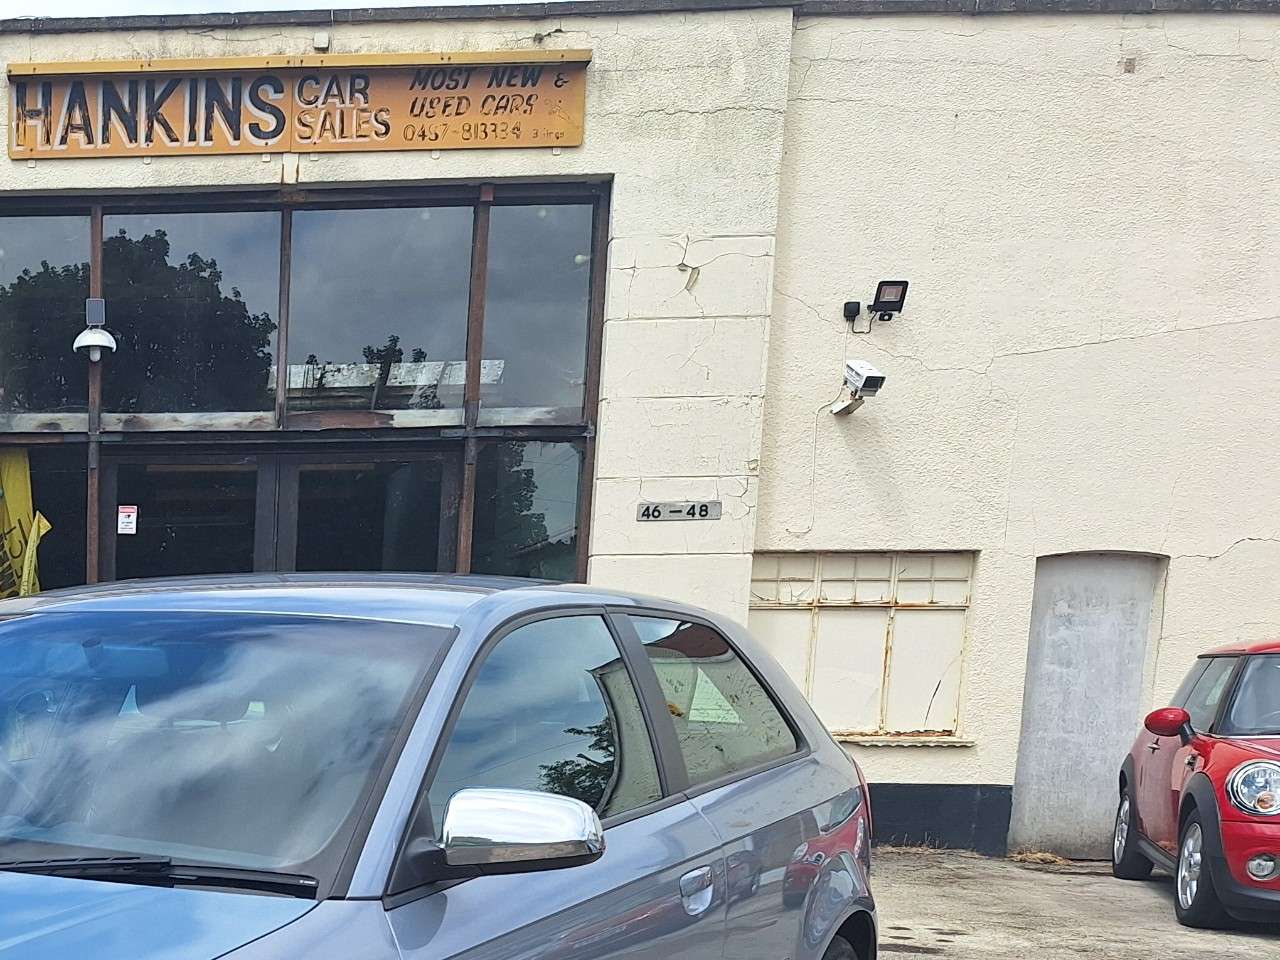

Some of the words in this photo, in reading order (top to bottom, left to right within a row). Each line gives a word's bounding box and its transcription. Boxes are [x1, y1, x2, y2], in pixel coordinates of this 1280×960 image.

[296, 73, 370, 106] CAR
[409, 67, 475, 92] MOST
[486, 65, 545, 89] NEW
[553, 72, 569, 88] &
[15, 75, 286, 147] HANKINS
[409, 95, 471, 118] USED
[479, 93, 540, 116] CARS
[296, 106, 391, 142] SALES
[640, 505, 662, 519] 46
[686, 503, 709, 518] 48
